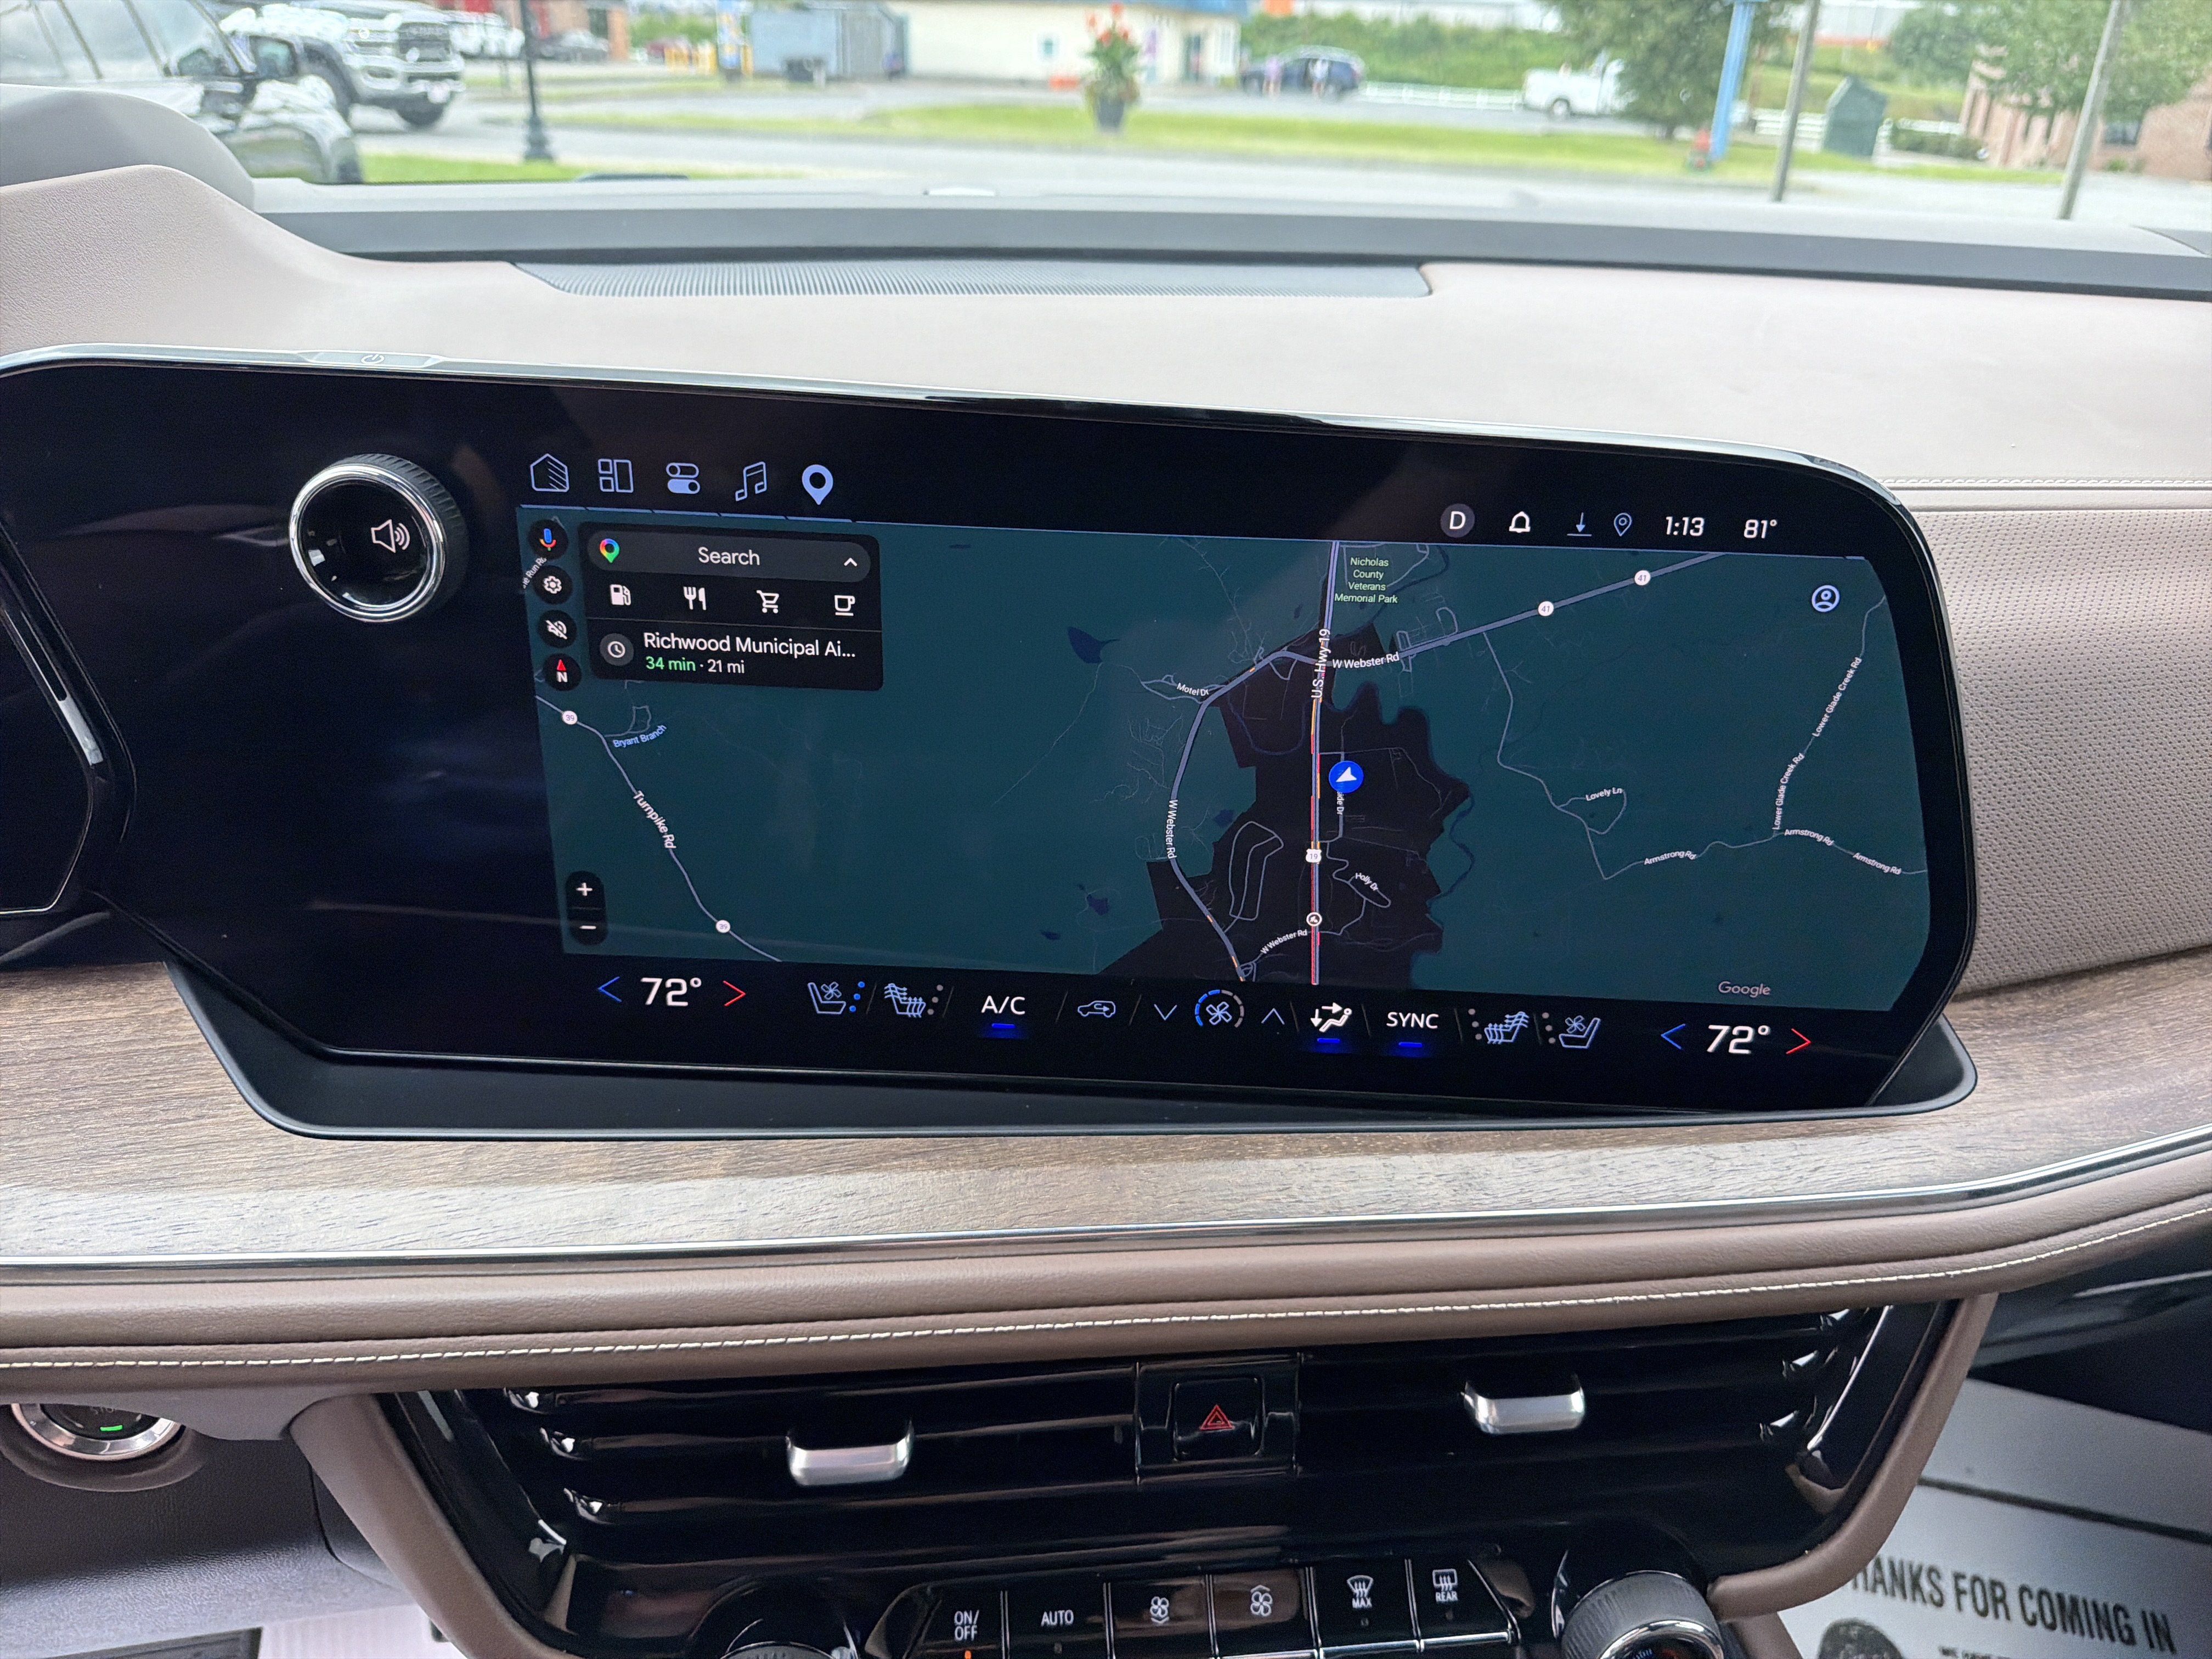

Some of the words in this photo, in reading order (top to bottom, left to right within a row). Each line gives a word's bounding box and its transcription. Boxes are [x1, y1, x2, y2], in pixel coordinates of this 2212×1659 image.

[1449, 511, 1466, 529] D
[1666, 516, 1705, 537] 1:13
[1743, 519, 1778, 539] 81°
[698, 546, 760, 566] Search
[1350, 557, 1389, 567] Nicholas
[1353, 569, 1384, 580] County
[1348, 581, 1386, 591] Veterans
[1334, 593, 1375, 602] Memorial
[1378, 594, 1398, 603] Park
[1318, 629, 1331, 642] 19
[643, 632, 731, 652] Richwood
[736, 636, 819, 659] Municipal
[645, 656, 665, 670] 34
[668, 657, 696, 672] min
[707, 659, 723, 673] 21
[727, 660, 745, 673] mi
[1314, 646, 1331, 673] Hwy
[1332, 658, 1342, 669] W
[1344, 656, 1385, 669] Webster
[1386, 651, 1400, 663] Rd
[556, 671, 568, 682] N
[1176, 682, 1199, 696] Motel
[1311, 676, 1324, 698] U.S.
[1812, 713, 1830, 737] Lower
[1825, 692, 1842, 713] Glade
[1838, 668, 1856, 691] Creek
[1850, 657, 1862, 669] Rd
[612, 736, 640, 748] Bryant
[639, 724, 667, 742] Branch
[1792, 752, 1805, 764] Rd
[1780, 763, 1797, 784] Creek
[1585, 788, 1611, 801] Lovely
[1775, 785, 1786, 806] Glade
[1169, 799, 1178, 809] W
[1336, 806, 1345, 815] Dr
[633, 790, 668, 833] Turnpike
[662, 834, 677, 849] Rd
[1771, 806, 1783, 830] Lower
[1165, 810, 1177, 846] Webster
[1784, 829, 1824, 842] Armstrong
[1822, 836, 1835, 846] Rd
[1166, 847, 1177, 859] Rd
[1644, 851, 1685, 865] Armstrong
[1684, 850, 1697, 860] Rd
[1852, 852, 1891, 873] Armstrong
[1889, 866, 1902, 875] Rd
[1355, 872, 1373, 884] Holly
[1370, 882, 1379, 891] Dr
[1260, 946, 1269, 955] W
[1266, 932, 1297, 949] Webster
[1297, 929, 1308, 937] Rd
[640, 977, 702, 1007] 72°
[1718, 981, 1771, 998] Google
[981, 995, 1026, 1016] A/C
[1386, 1011, 1439, 1029] SYNC
[1706, 1024, 1771, 1054] 72°
[1352, 1597, 1372, 1609] MAX
[1435, 1590, 1459, 1602] REAR
[953, 1609, 980, 1626] ON/
[1040, 1609, 1074, 1627] AUTO
[1952, 1571, 2011, 1621] FOR
[2018, 1584, 2135, 1646] COMING
[2141, 1611, 2178, 1655] IN
[954, 1624, 978, 1641] OFF
